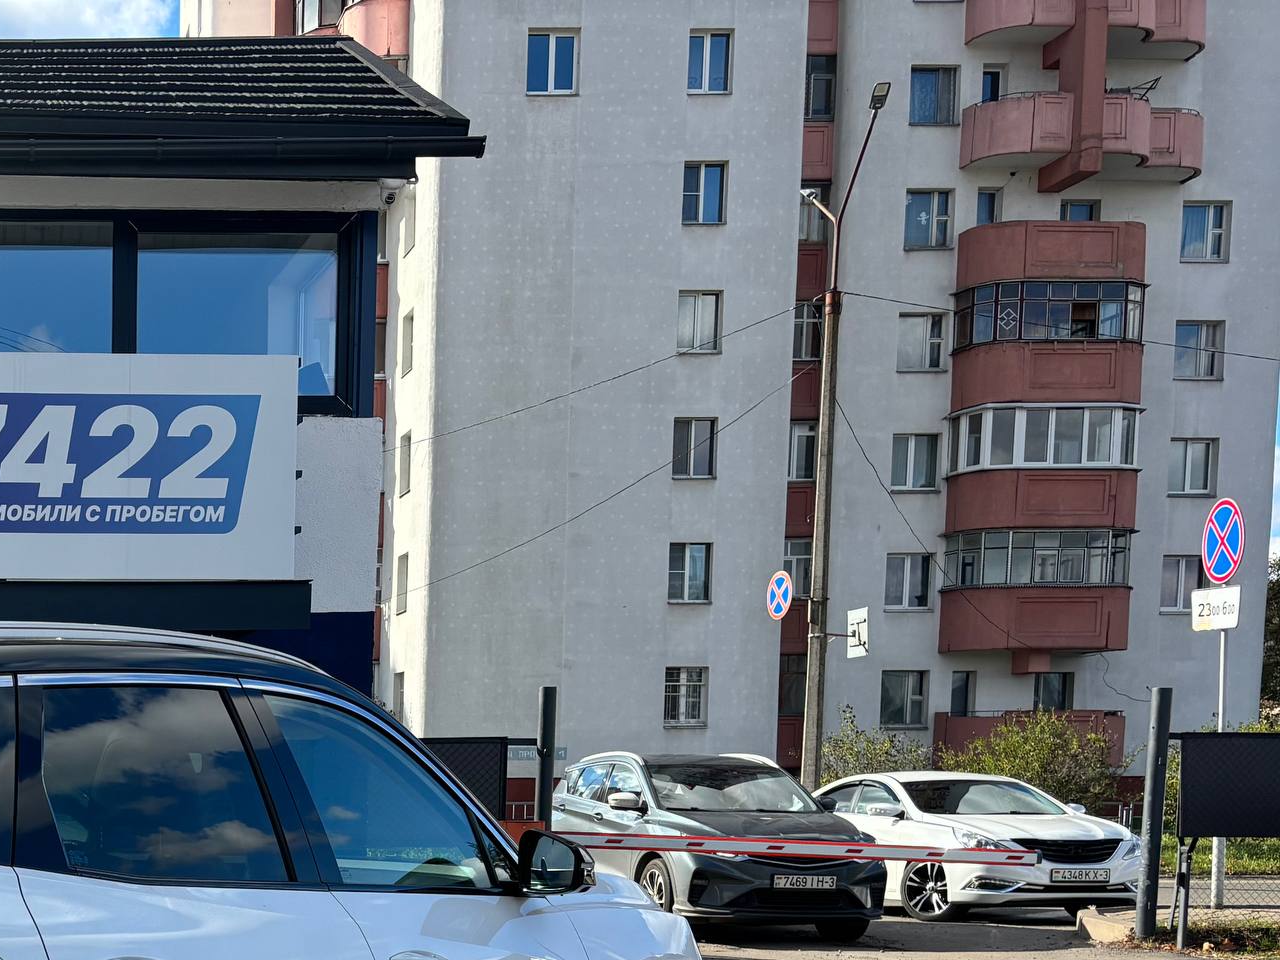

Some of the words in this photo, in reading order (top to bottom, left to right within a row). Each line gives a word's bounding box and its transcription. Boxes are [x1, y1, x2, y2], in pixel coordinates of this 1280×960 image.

[85, 504, 101, 522] С
[105, 504, 226, 523] ПРОБЕГОМ
[1061, 870, 1084, 880] 4348
[783, 876, 808, 888] 7469
